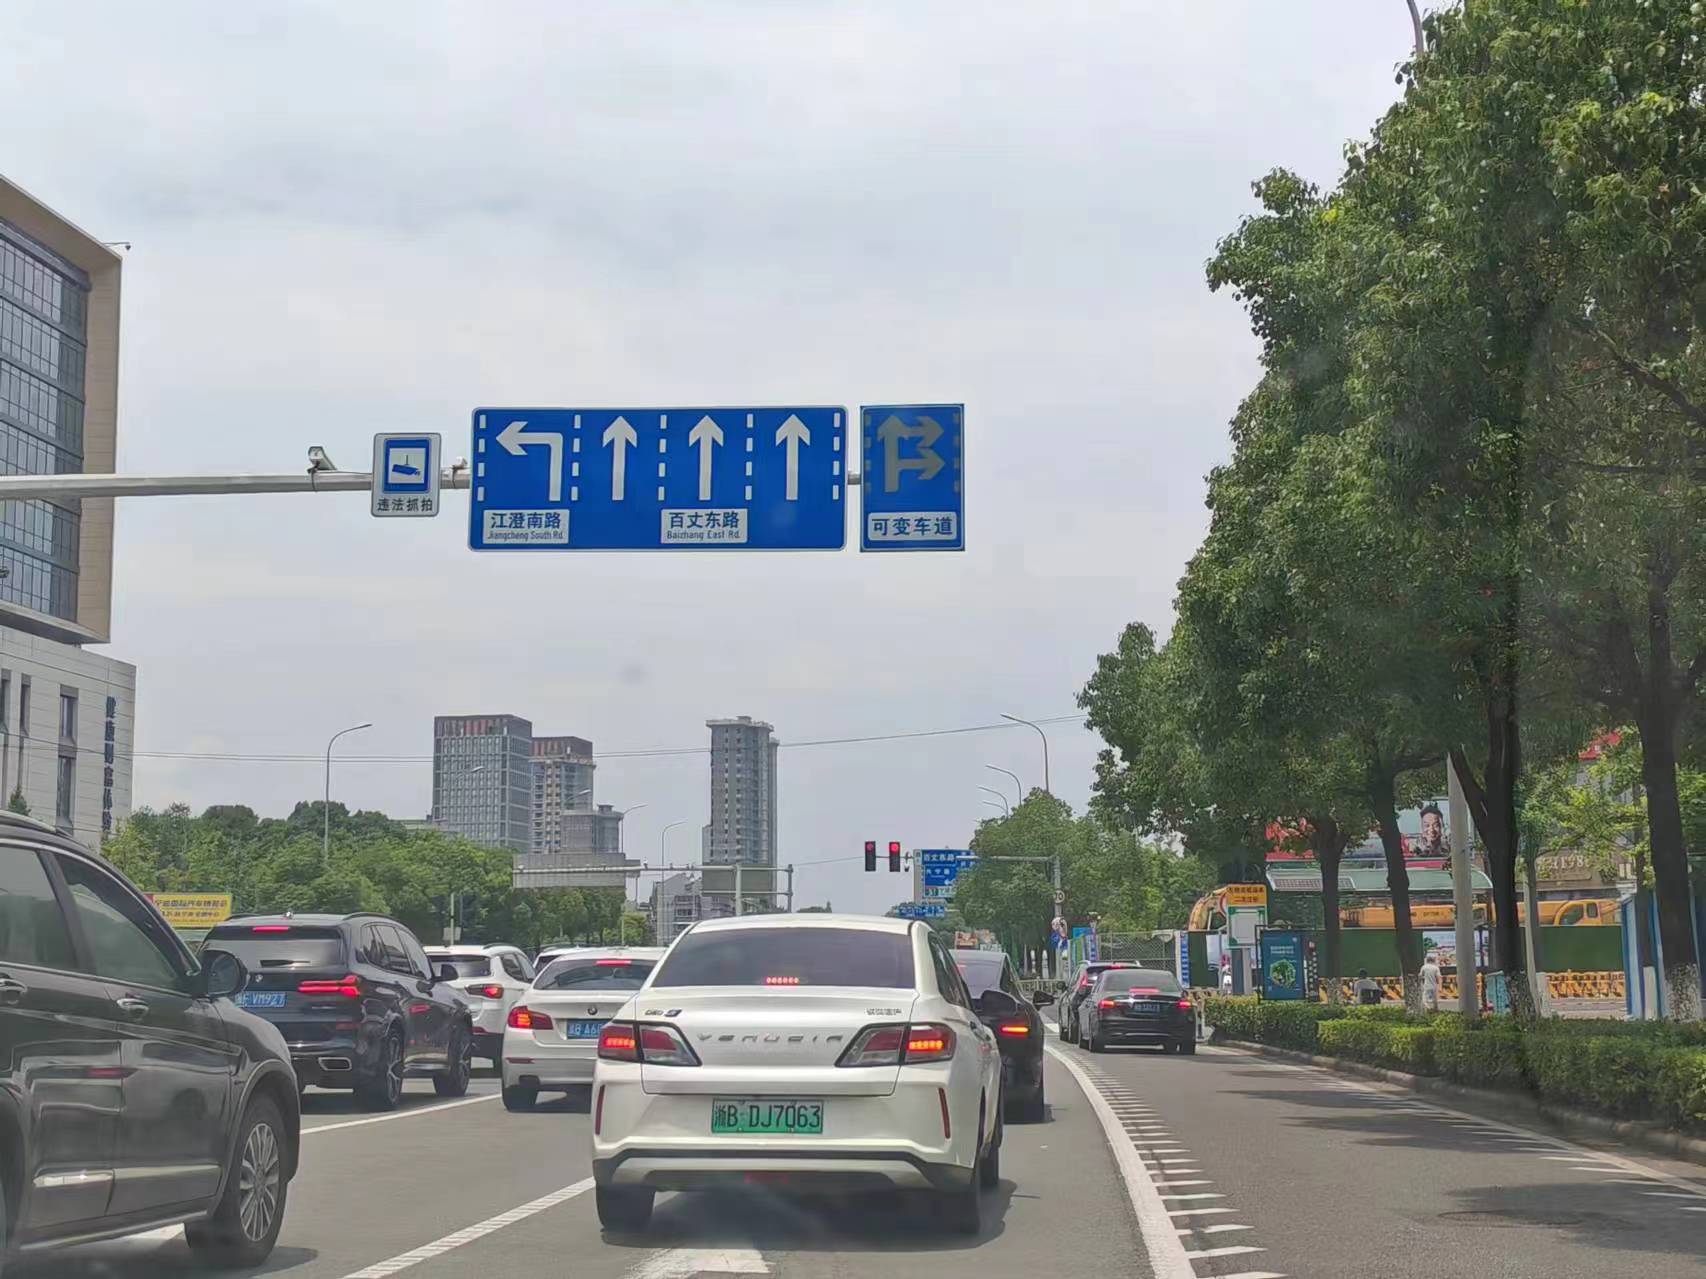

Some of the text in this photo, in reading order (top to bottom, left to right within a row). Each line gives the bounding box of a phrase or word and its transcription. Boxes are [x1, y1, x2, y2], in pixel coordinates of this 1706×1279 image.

[377, 497, 433, 511] 违法抓拍
[490, 512, 561, 529] 江澄南路
[668, 511, 740, 529] 百丈东路
[871, 516, 953, 536] 可变车道
[530, 530, 551, 540] South
[667, 530, 704, 541] Baizhang
[707, 529, 725, 540] East
